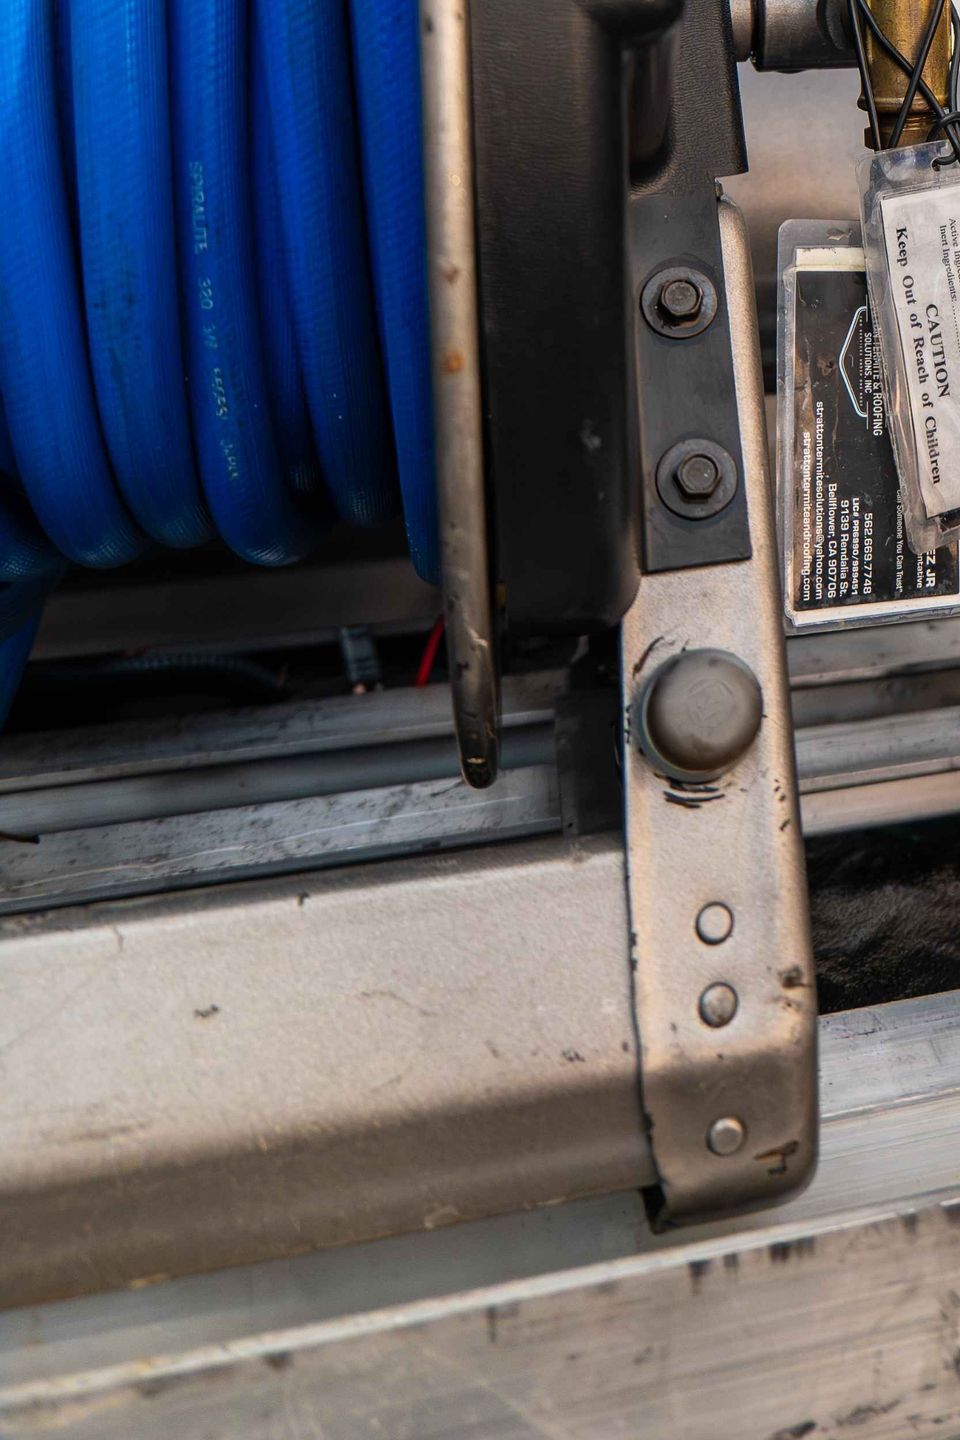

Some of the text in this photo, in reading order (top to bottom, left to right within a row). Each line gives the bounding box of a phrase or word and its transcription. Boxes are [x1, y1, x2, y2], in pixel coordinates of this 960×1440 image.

[940, 224, 949, 246] Inert
[949, 218, 960, 247] Active
[942, 249, 958, 302] Ingredients:
[873, 382, 880, 390] &
[896, 226, 942, 484] Keep Out of Reach of Children
[926, 304, 950, 399] CAUTION
[873, 393, 882, 436] ROOFING
[801, 432, 812, 601] strattontermiteandroofing.com
[814, 402, 825, 600] strattontermitesolutions@yahoo.com
[827, 483, 837, 598] Bellflower, CA 90706
[840, 500, 849, 597] 9139 Rendalia St.
[863, 513, 873, 594] 562.669.7748
[926, 569, 935, 587] JR
